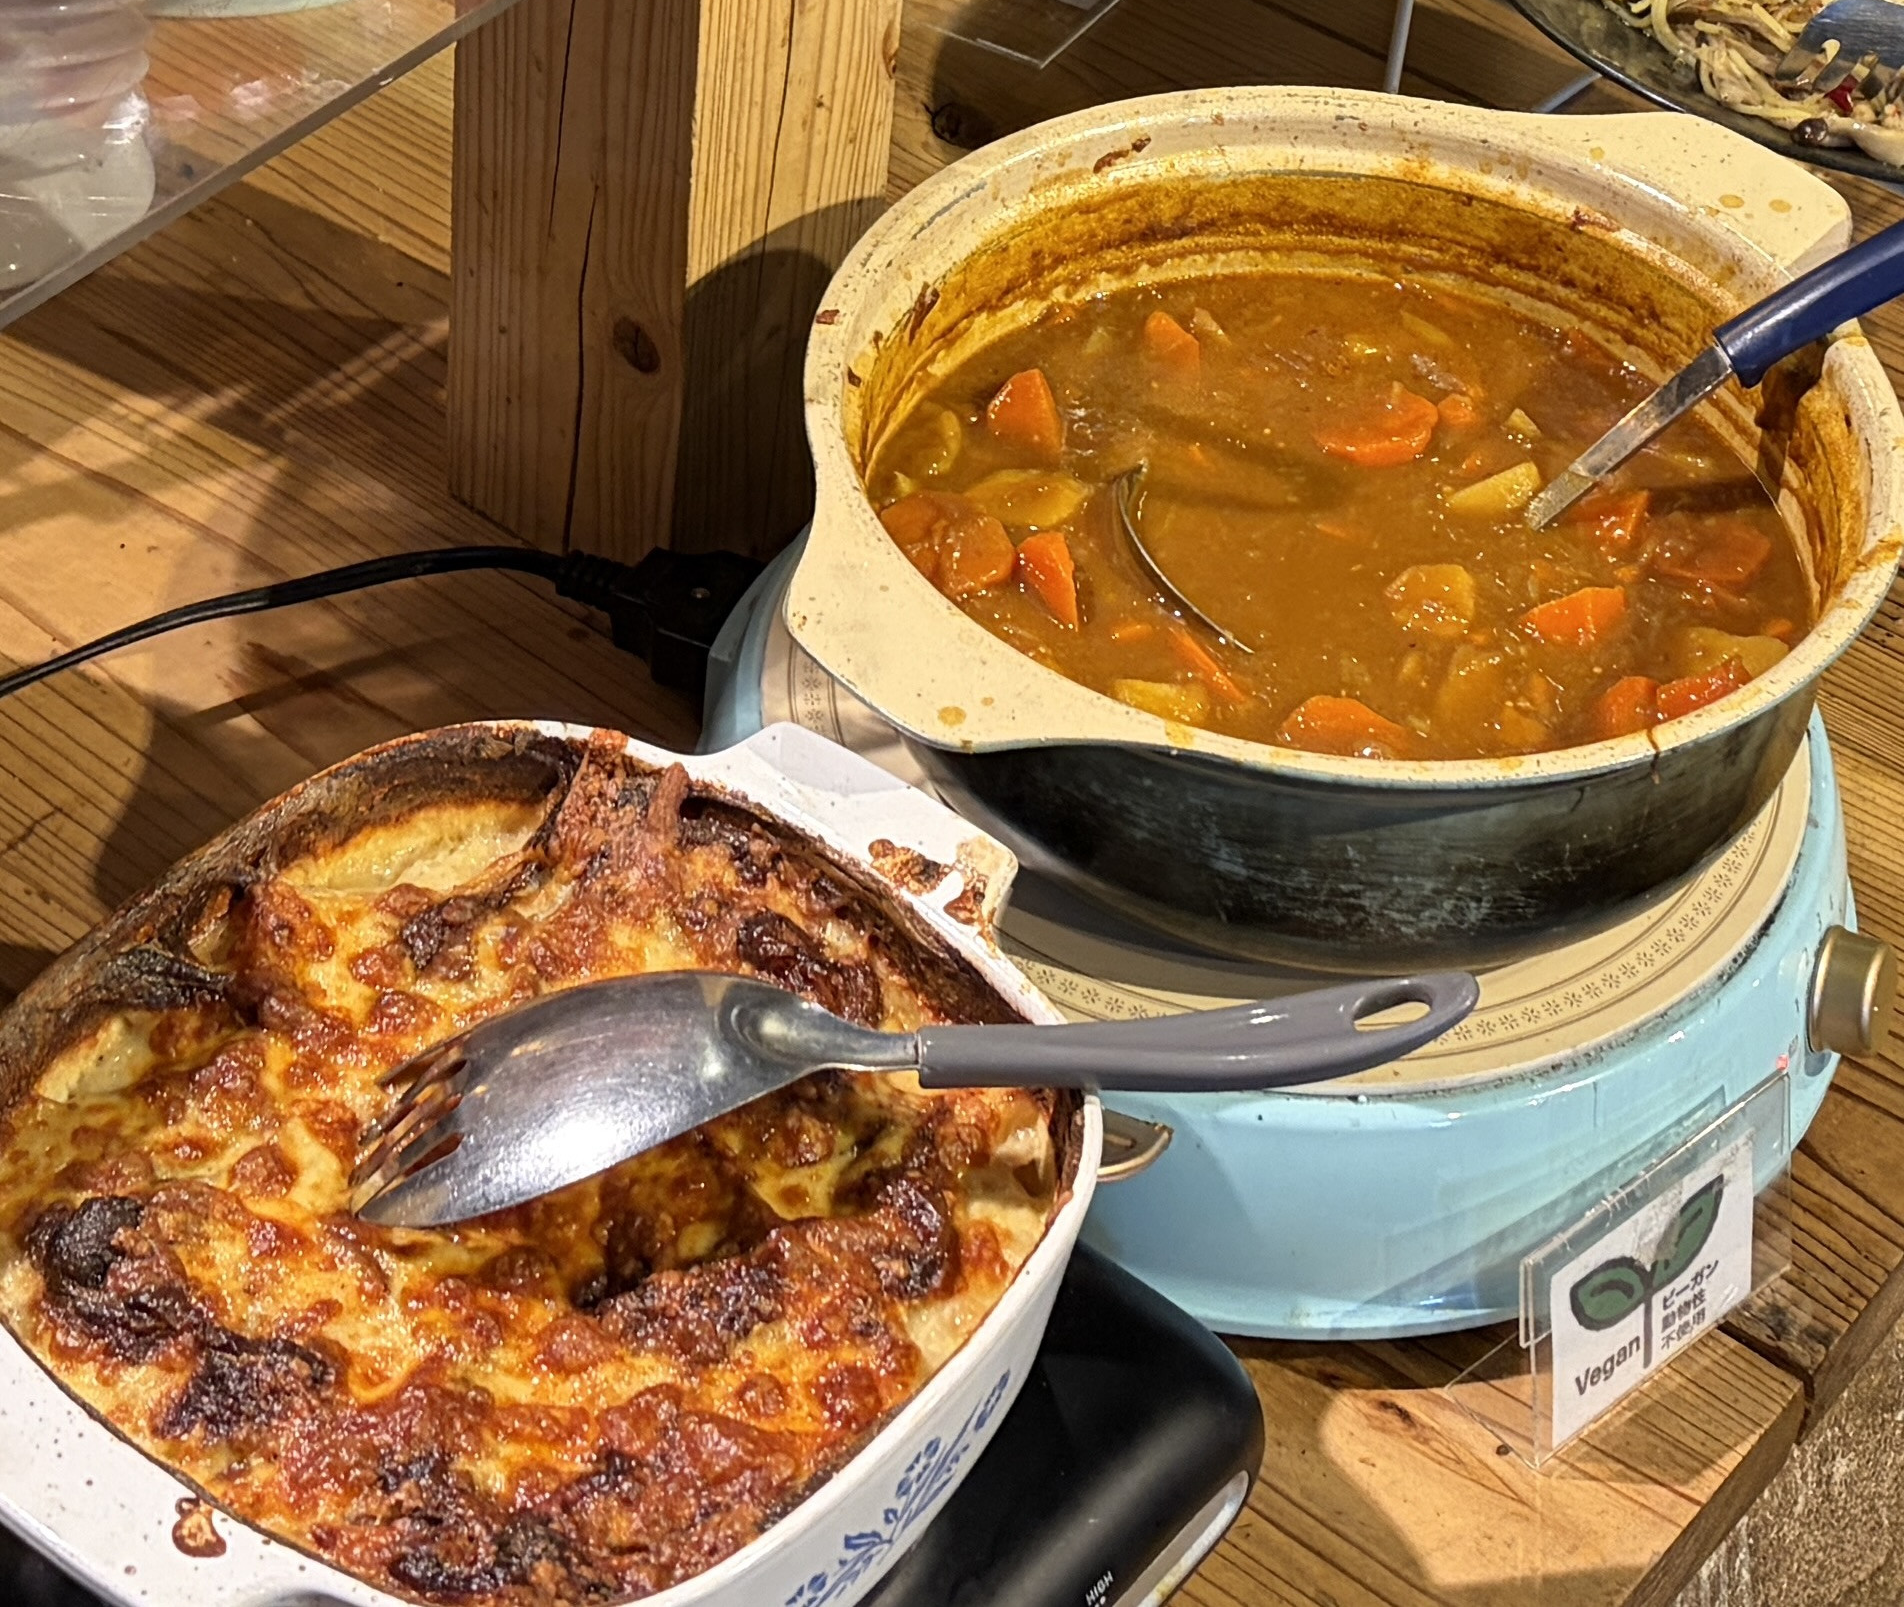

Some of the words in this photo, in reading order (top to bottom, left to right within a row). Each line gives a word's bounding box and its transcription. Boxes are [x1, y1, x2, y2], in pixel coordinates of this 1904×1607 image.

[1661, 1259, 1719, 1311] ビーガン
[1574, 1334, 1642, 1397] Vegan
[1085, 1570, 1115, 1607] HIGH
